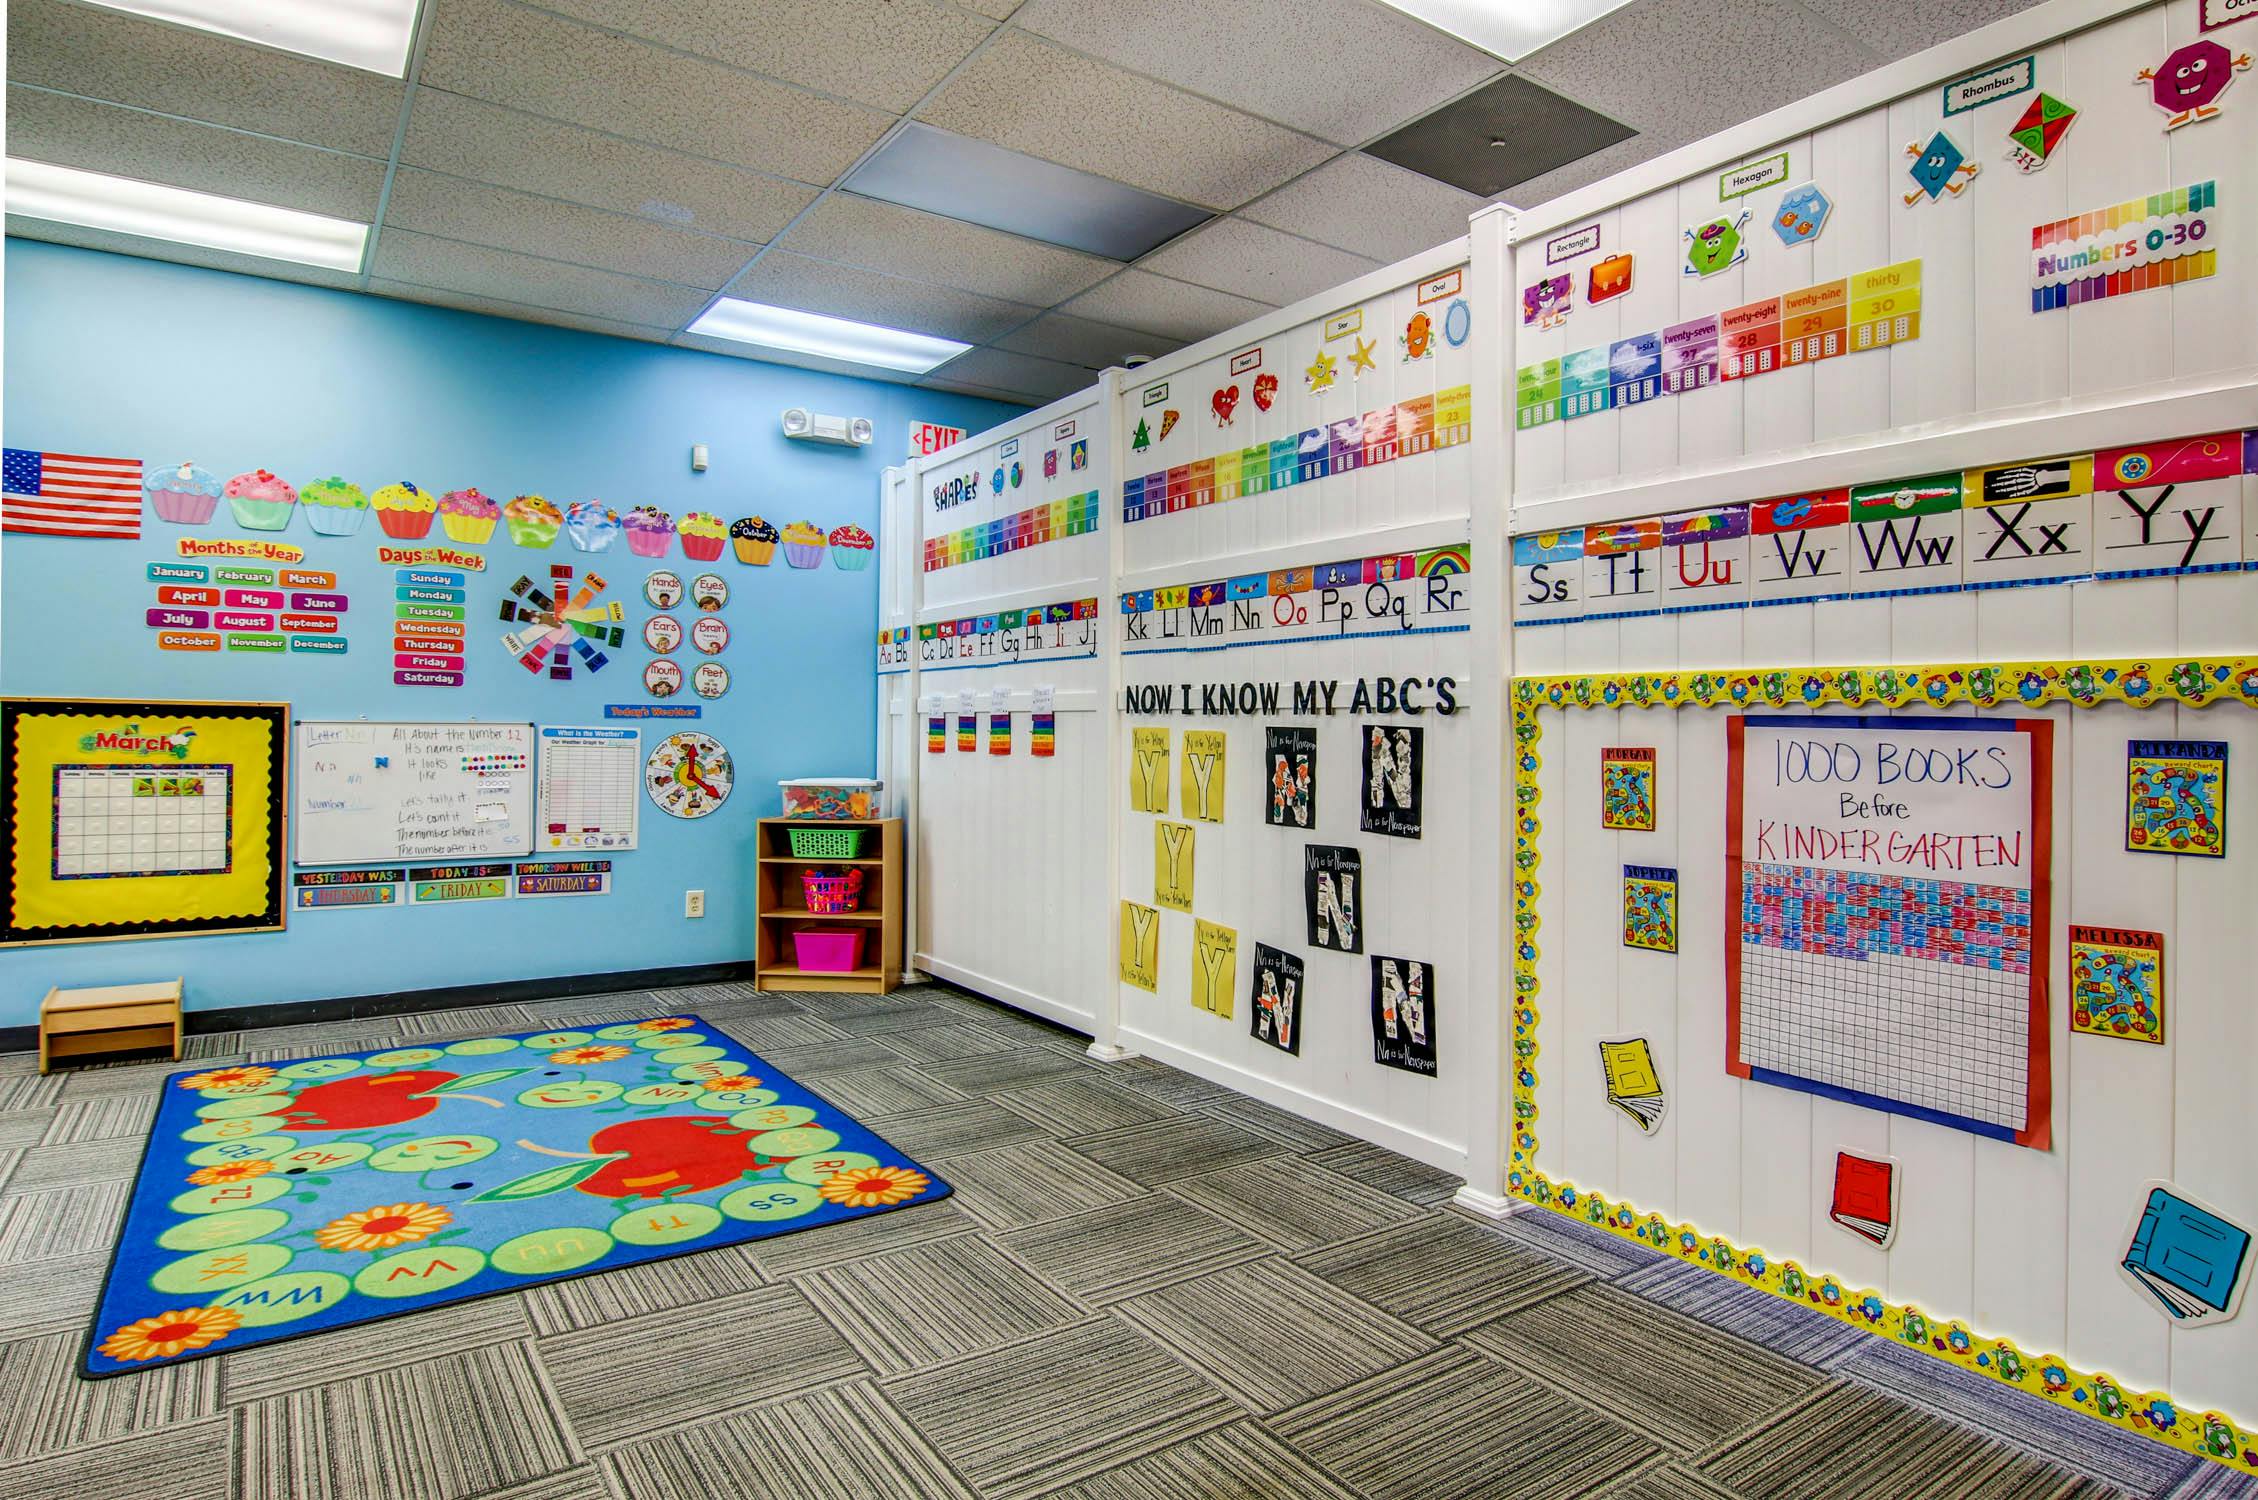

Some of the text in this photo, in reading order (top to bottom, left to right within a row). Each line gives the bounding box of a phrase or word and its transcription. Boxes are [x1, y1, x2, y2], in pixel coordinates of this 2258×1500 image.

[1962, 75, 2014, 100] Rhombus
[1733, 167, 1773, 187] Hexagon
[1556, 235, 1590, 252] Rectangle
[2038, 219, 2206, 277] Numbers 0-30
[1866, 271, 1900, 288] thirty
[1433, 281, 1445, 293] Oval
[1787, 288, 1842, 310] twenty-nine
[1872, 299, 1895, 315] 30
[1724, 305, 1776, 327] twenty-eight
[1338, 321, 1348, 329] Star
[1803, 318, 1822, 332] 29
[1665, 323, 1716, 344] twenty-seven
[1738, 333, 1758, 347] 28
[1240, 357, 1252, 366] Heart
[1680, 348, 1698, 361] 27
[1529, 389, 1543, 401] 24
[1447, 412, 1458, 422] 23
[922, 424, 960, 455] EXIT
[935, 477, 977, 512] SHAPES
[459, 501, 480, 515] May
[743, 528, 767, 539] October
[1858, 485, 2214, 570] Ww Xx Yy
[181, 539, 245, 554] Months
[264, 542, 302, 560] Year
[379, 547, 422, 563] Days
[437, 549, 484, 568] Week
[1528, 530, 1825, 602] Ss Tt Uu Vv
[152, 566, 204, 581] January
[217, 569, 271, 583] February
[288, 573, 327, 584] March
[410, 573, 451, 584] Sunday
[652, 578, 679, 588] Hands
[700, 580, 723, 590] Eyes
[172, 589, 207, 603] April
[241, 593, 268, 606] May
[410, 590, 452, 600] Monday
[304, 597, 336, 608] June
[1128, 613, 1147, 639] Kk
[1191, 607, 1223, 635] Mm
[1234, 600, 1259, 629] Nn
[1273, 594, 1307, 625] Oo
[1322, 589, 1352, 634] Pp
[1366, 583, 1412, 630] Qq
[1428, 576, 1463, 611] Rr
[162, 611, 194, 625] July
[408, 607, 454, 617] Tuesday
[222, 614, 266, 626] August
[282, 617, 335, 629] September
[653, 621, 676, 631] Ears
[401, 623, 460, 634] Wednesday
[699, 623, 727, 633] Brain
[164, 635, 216, 646] October
[230, 637, 283, 647] November
[294, 639, 345, 649] December
[404, 639, 454, 650] Thursday
[940, 636, 953, 659] Dd
[961, 636, 972, 656] Ee
[981, 630, 995, 656] Ff
[1002, 629, 1019, 662] Gg
[1027, 625, 1042, 649] Hh
[413, 657, 447, 667] Friday
[651, 666, 679, 675] Mouth
[703, 668, 723, 677] Feet
[404, 673, 454, 683] Saturday
[1126, 677, 1456, 716] NOW I KNOW MY ABC'S
[611, 707, 696, 718] Today's Weather
[393, 728, 406, 740] All
[412, 728, 440, 739] About
[446, 729, 465, 739] the
[469, 728, 502, 740] Number
[96, 733, 173, 751] March
[1607, 749, 1651, 760] MORGAN
[2133, 741, 2225, 758] MIRANDA
[375, 757, 388, 768] N
[1777, 739, 2011, 788] 1000 BOOKS
[1138, 751, 1160, 812] Y
[1189, 754, 1215, 819] Y
[1840, 792, 1911, 819] Before
[1758, 819, 2021, 870] KINDERGARTEN
[1163, 824, 1186, 889] Y
[431, 868, 469, 879] TODAY
[518, 862, 569, 873] TOMORROW
[572, 862, 595, 871] WILL
[302, 872, 397, 884] YESTERDAY WAS:
[536, 877, 586, 891] SATURDAY
[318, 888, 376, 902] THURSDAY
[441, 882, 481, 897] FRIDAY
[1129, 904, 1152, 967] Y
[2076, 928, 2158, 948] MELISSA
[1200, 942, 1225, 1011] Y
